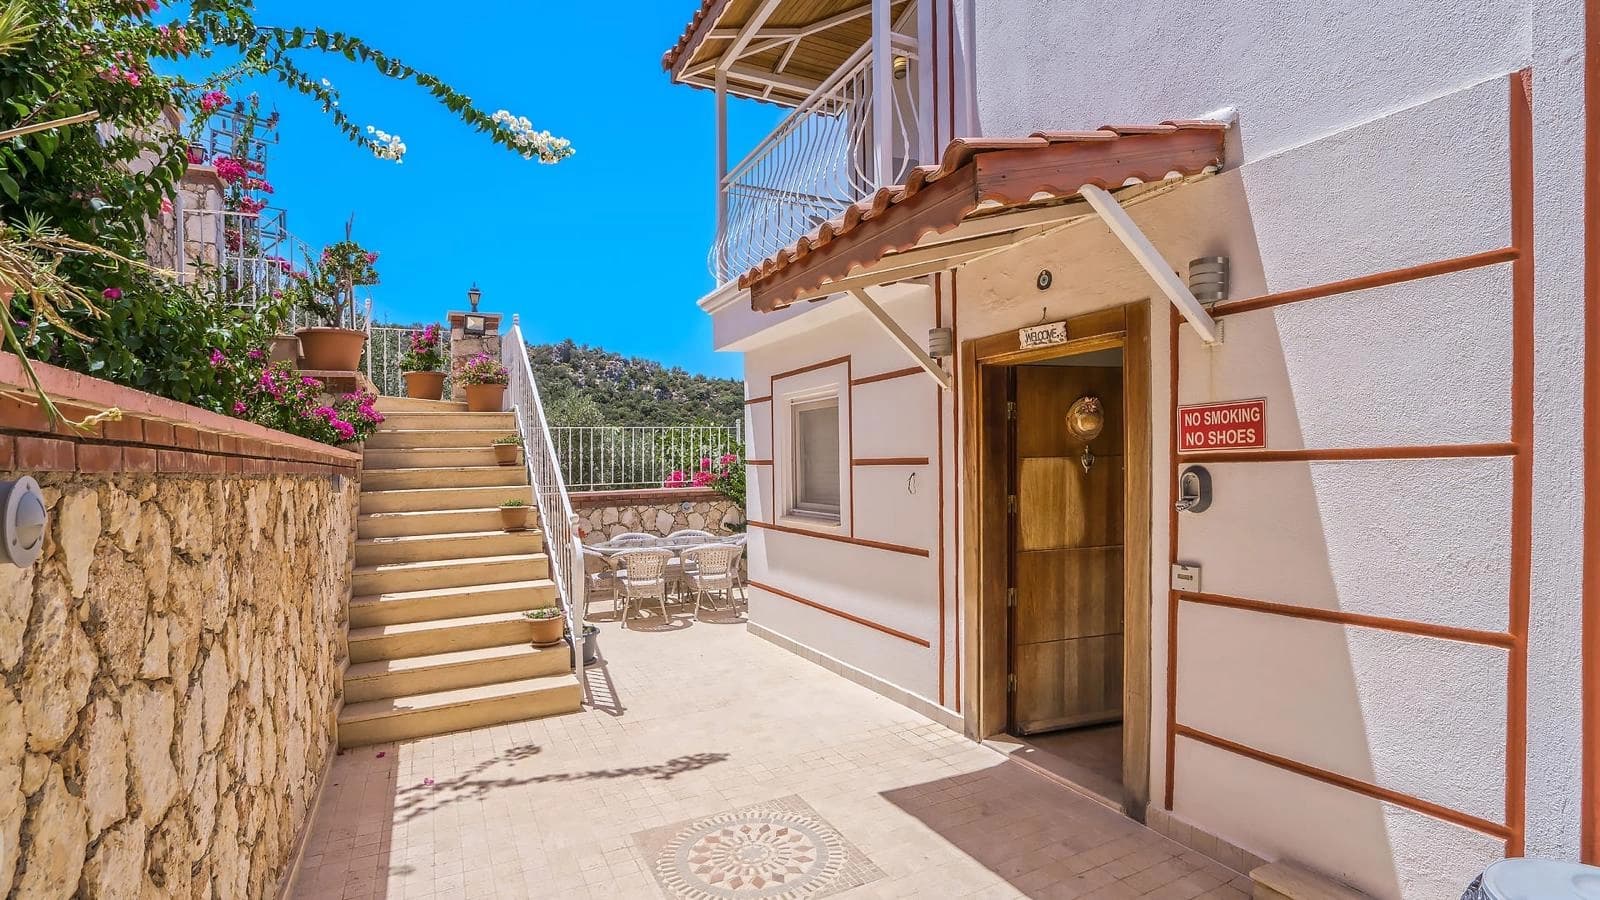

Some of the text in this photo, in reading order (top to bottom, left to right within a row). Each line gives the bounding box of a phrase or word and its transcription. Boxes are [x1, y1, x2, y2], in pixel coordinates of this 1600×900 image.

[1025, 328, 1057, 342] WELCOME
[1184, 407, 1261, 427] NO SMOKING
[1186, 428, 1256, 446] NO SHOES
